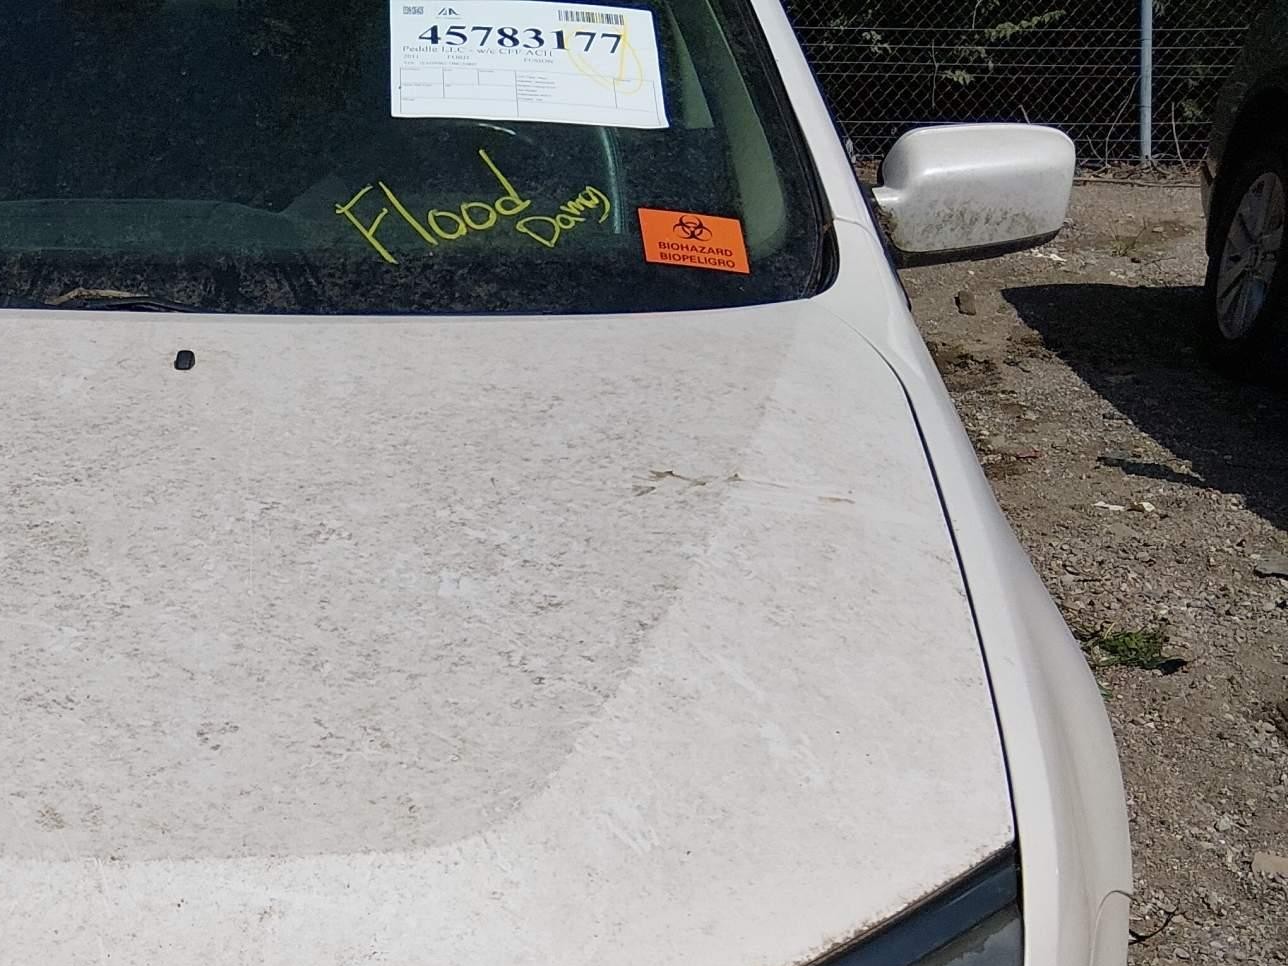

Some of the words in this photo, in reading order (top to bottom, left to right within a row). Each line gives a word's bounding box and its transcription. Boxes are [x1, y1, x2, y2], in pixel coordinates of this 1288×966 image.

[418, 25, 623, 54] 45783177
[335, 149, 531, 265] Flood
[657, 241, 734, 257] BIOHAZARD
[659, 252, 736, 269] BIOPELIGRO
